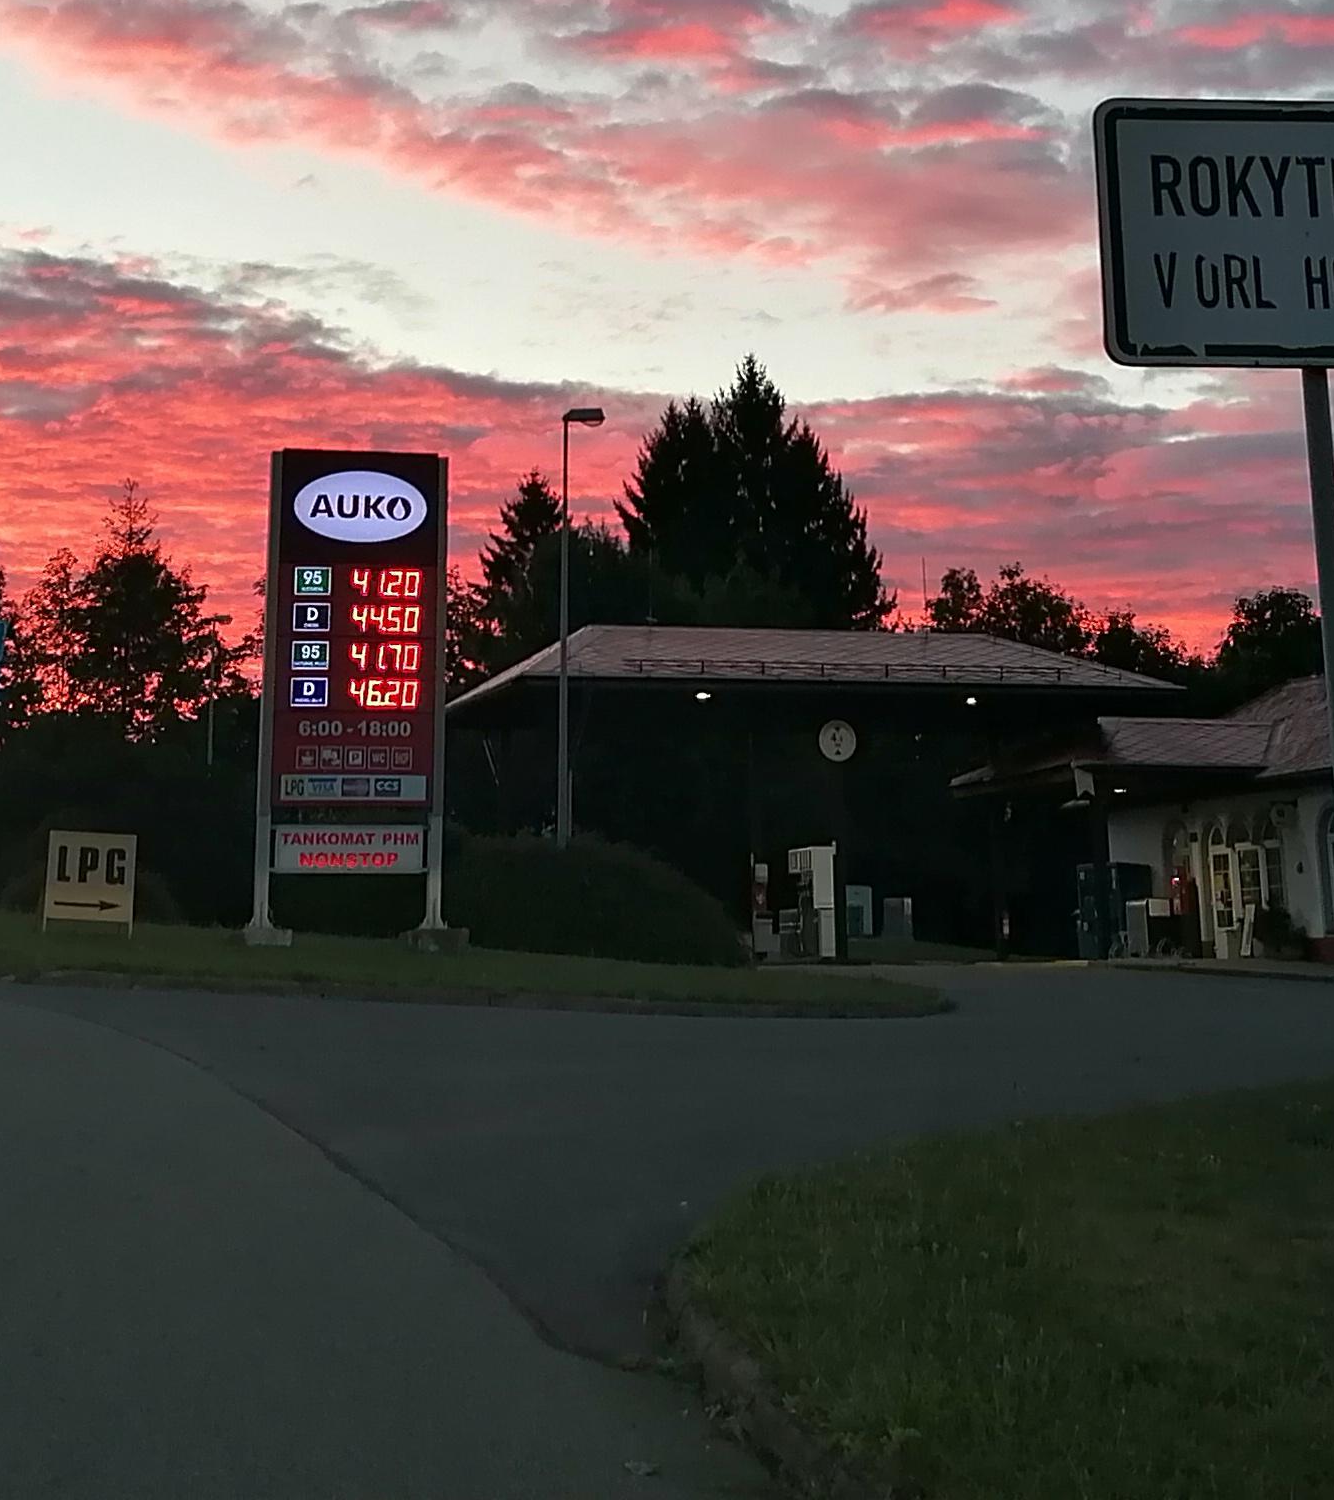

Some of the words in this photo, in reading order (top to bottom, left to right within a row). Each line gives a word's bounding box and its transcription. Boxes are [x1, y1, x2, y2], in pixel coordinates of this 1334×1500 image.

[1153, 251, 1178, 310] V
[309, 494, 411, 521] AUKO
[303, 571, 322, 585] 95
[306, 606, 319, 622] D
[301, 645, 320, 659] 95
[303, 682, 315, 696] D
[298, 720, 343, 738] 6:00
[357, 720, 412, 738] 18:00
[371, 752, 386, 765] WC
[284, 779, 305, 797] LPG
[281, 832, 376, 846] TANKOMAT
[382, 833, 419, 846] PHM
[56, 845, 126, 887] LPG
[298, 851, 399, 869] NONSTOP
